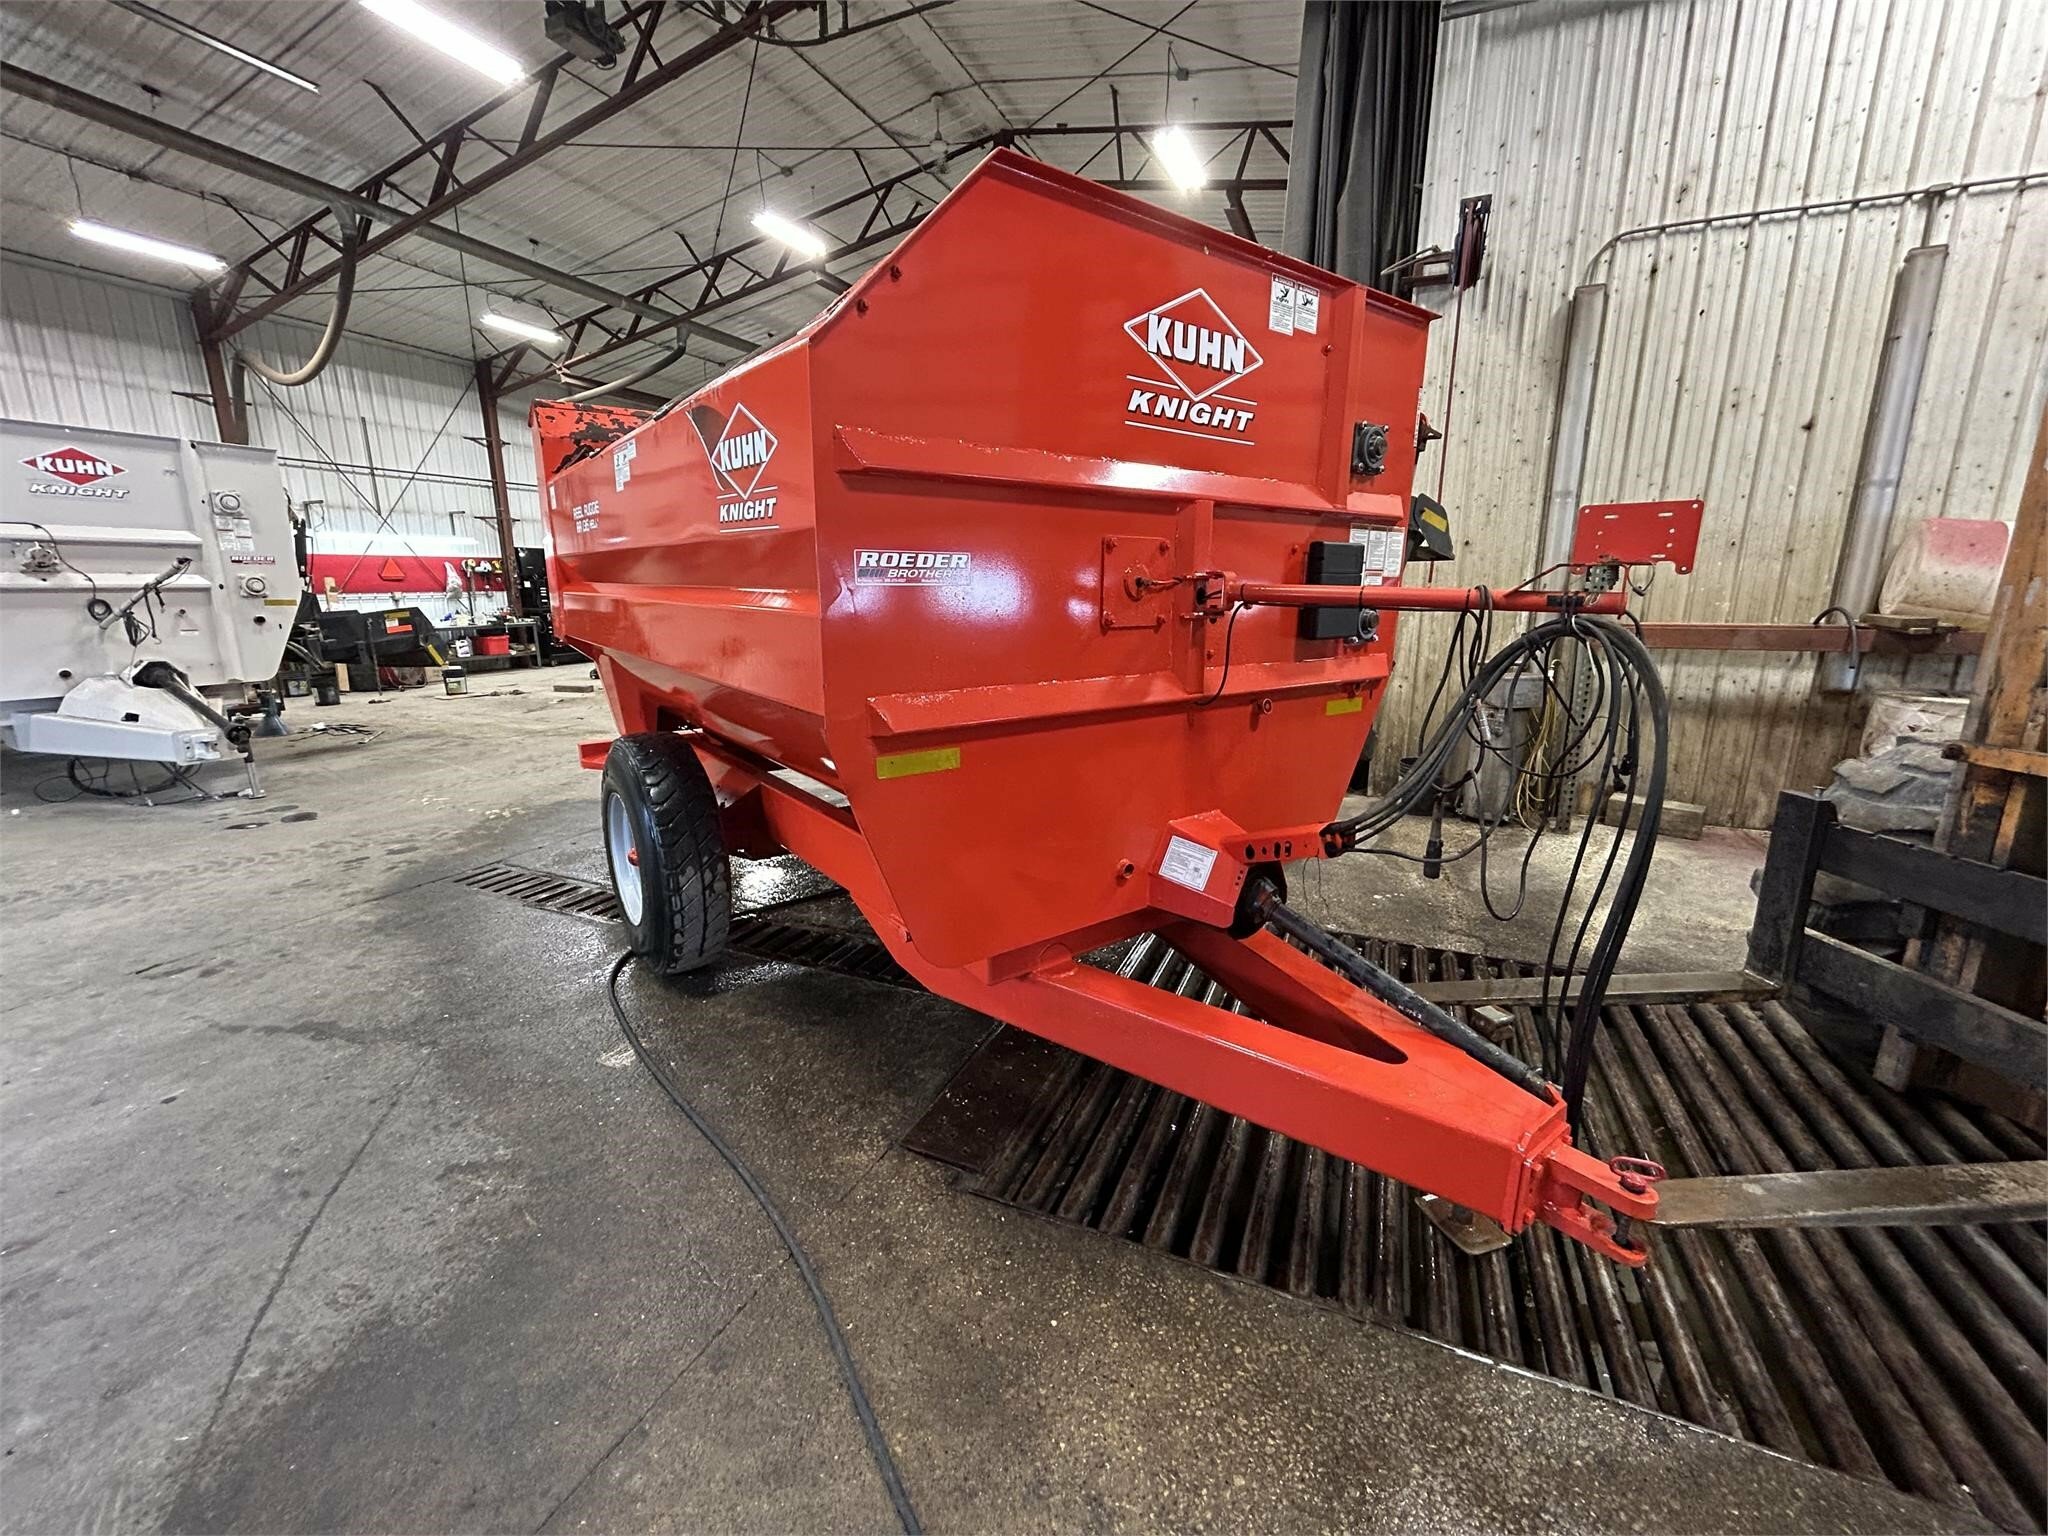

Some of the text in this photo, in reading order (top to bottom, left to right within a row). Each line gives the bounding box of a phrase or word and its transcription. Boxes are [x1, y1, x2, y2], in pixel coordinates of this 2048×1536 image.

[1147, 313, 1245, 374] KUHN
[1127, 390, 1254, 432] KNIGHT
[719, 429, 767, 473] KUHN
[36, 456, 114, 476] KUHN
[30, 483, 129, 498] KNIGHT
[720, 498, 777, 523] KNIGHT
[859, 551, 968, 568] ROEDER
